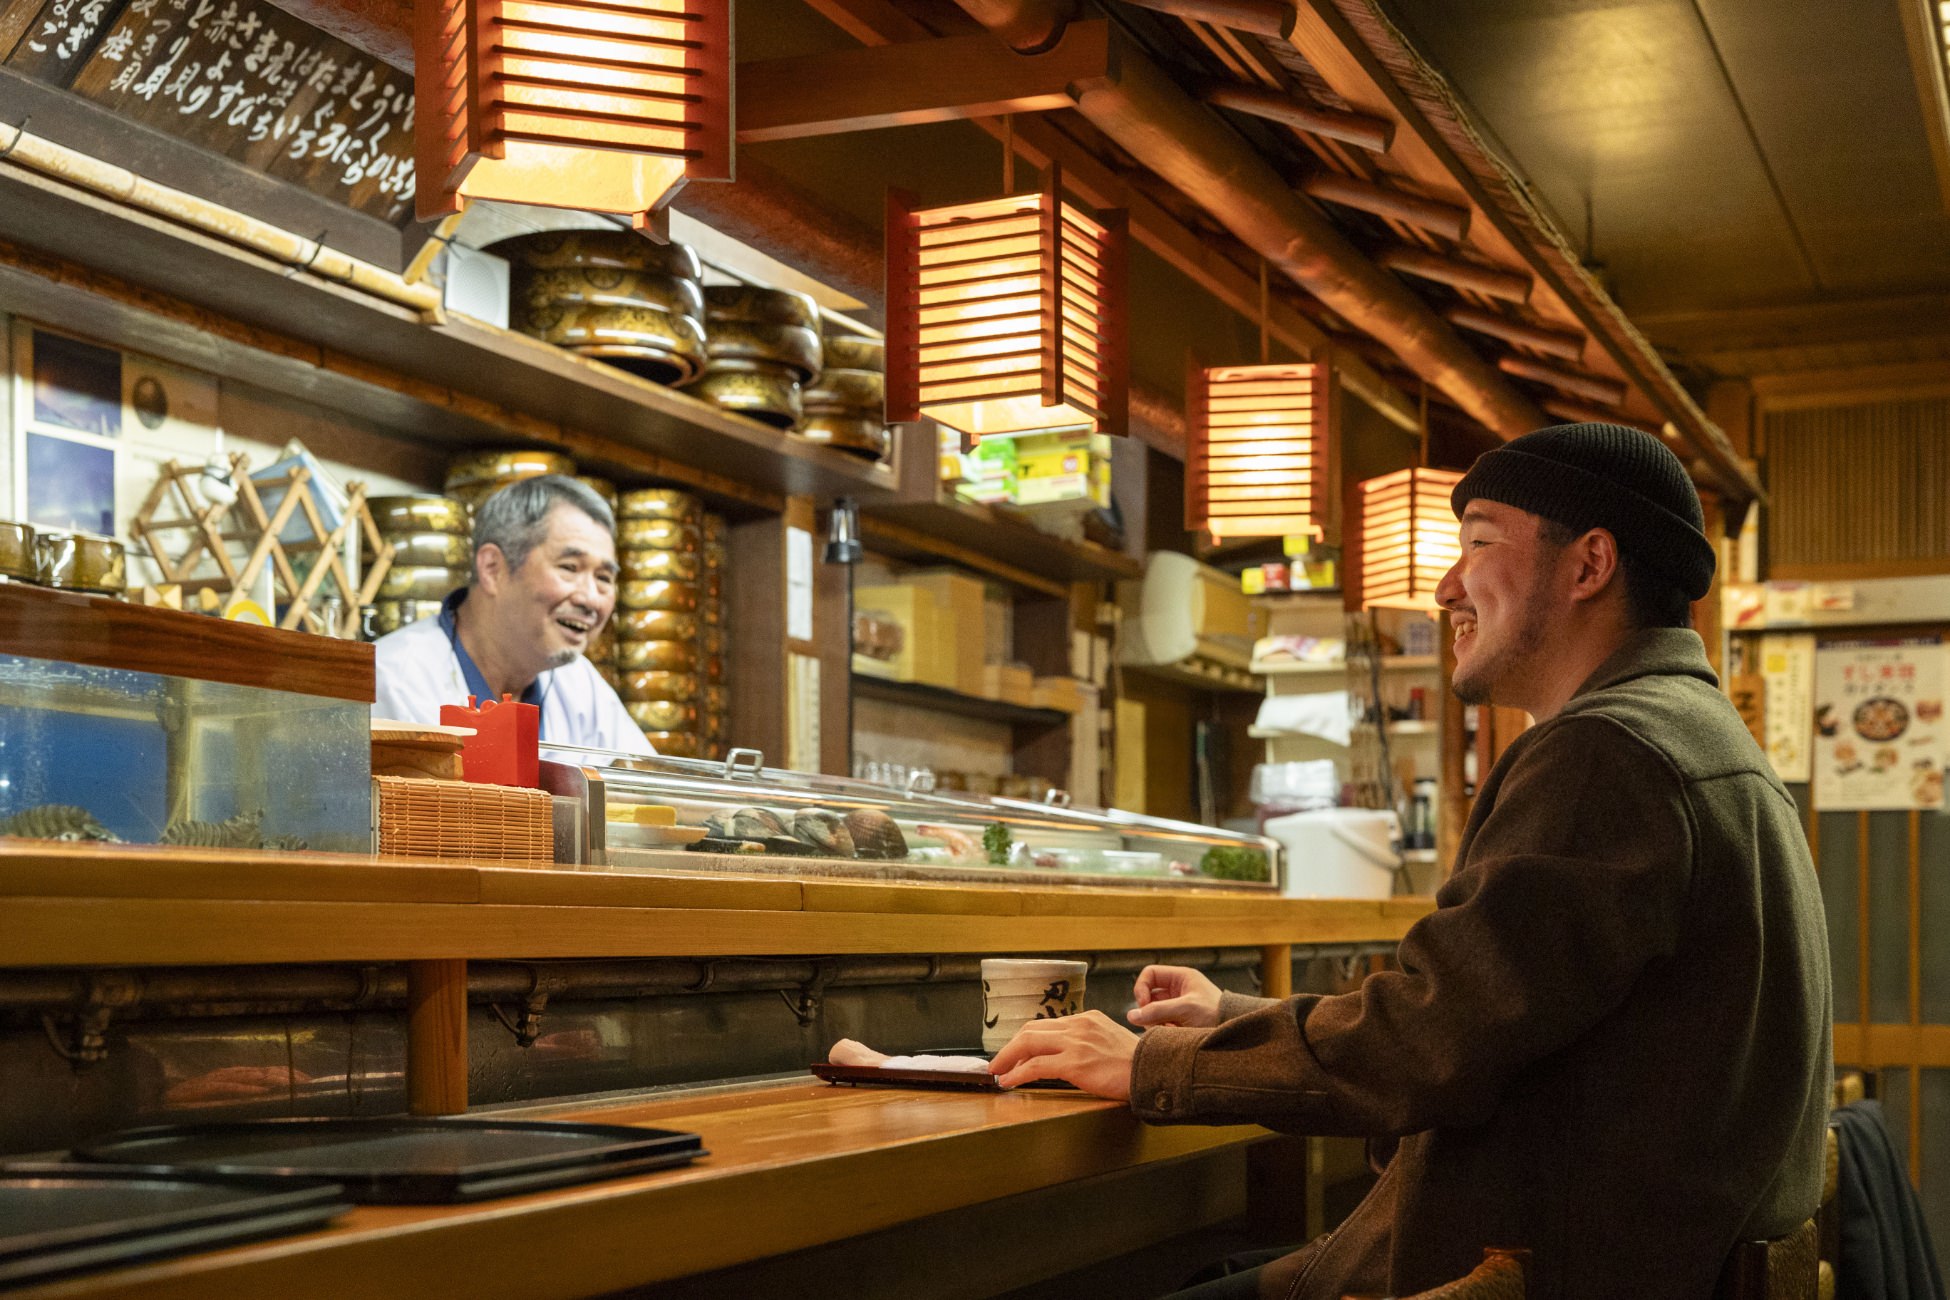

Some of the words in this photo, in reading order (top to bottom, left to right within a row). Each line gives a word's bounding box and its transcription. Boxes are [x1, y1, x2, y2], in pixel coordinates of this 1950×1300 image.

[110, 0, 188, 94] っき貝
[164, 1, 237, 102] 赤貝
[179, 12, 262, 114] さより
[209, 29, 278, 119] きす
[248, 47, 322, 141] はまち
[273, 58, 338, 140] たい
[289, 61, 362, 159] まぐろ
[313, 70, 376, 157] とろ
[331, 84, 396, 165] うに
